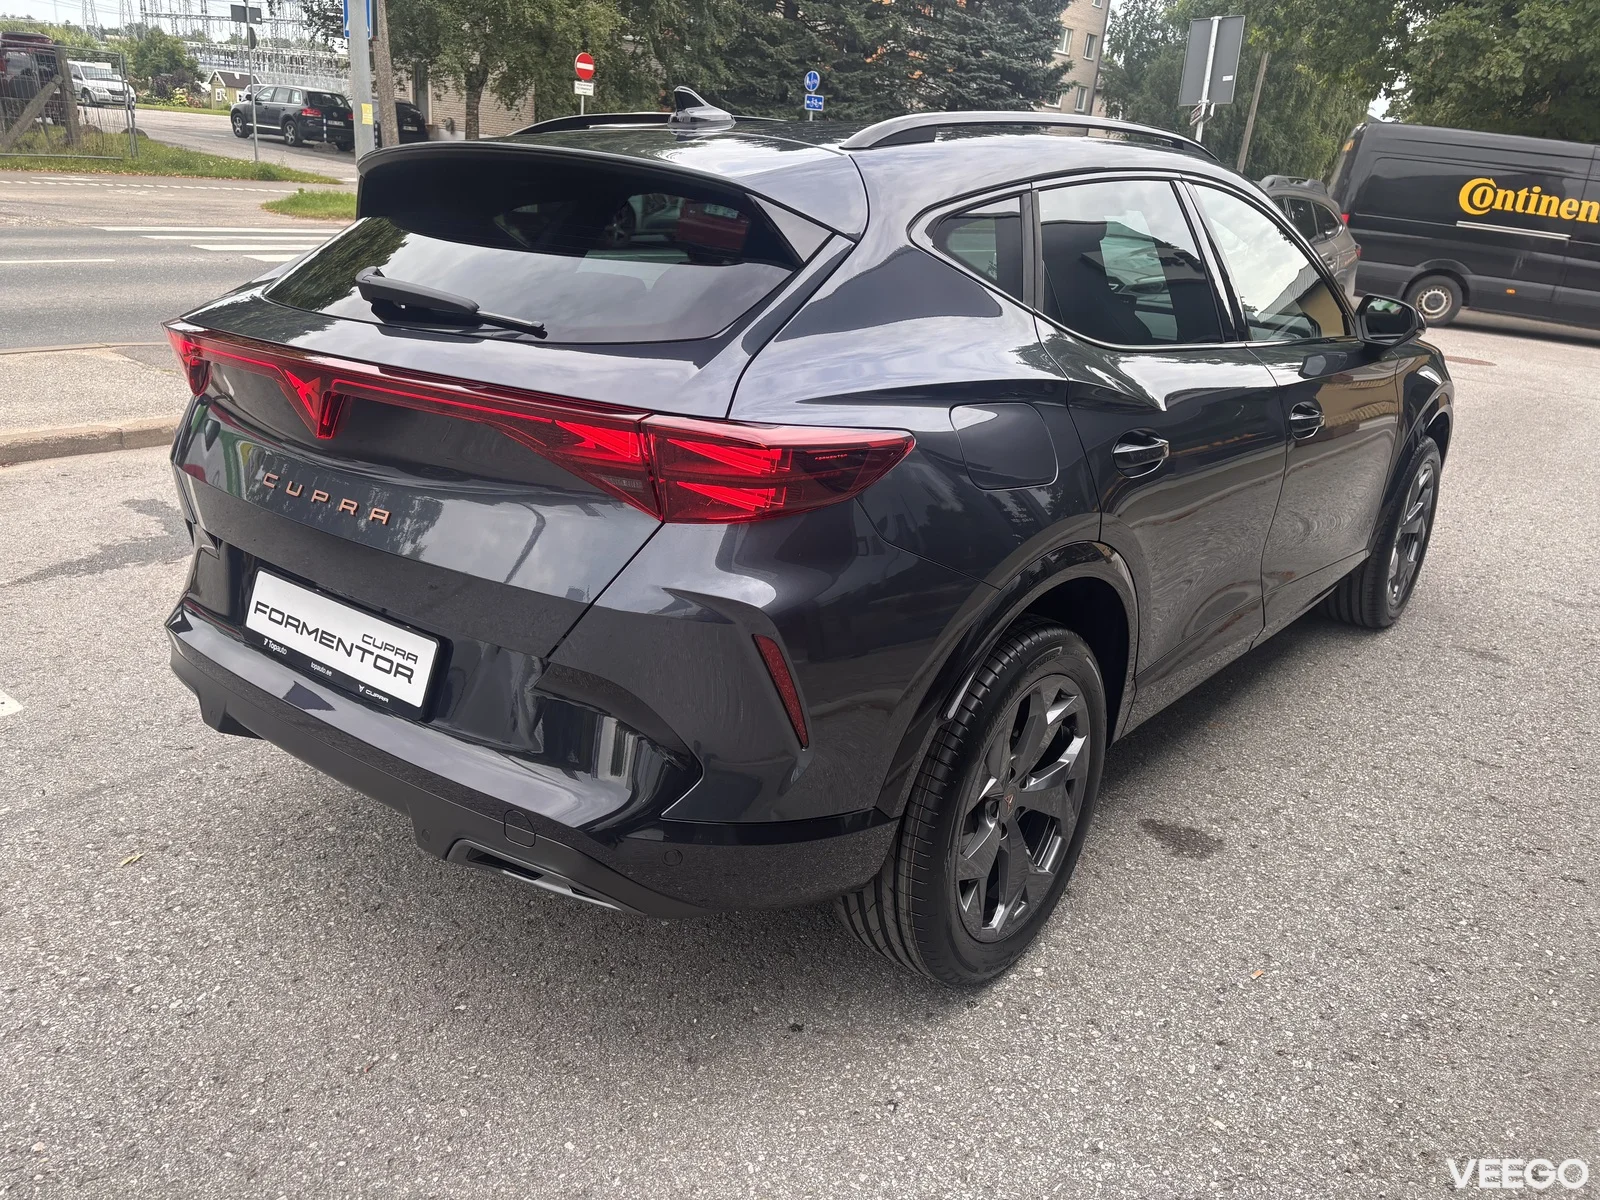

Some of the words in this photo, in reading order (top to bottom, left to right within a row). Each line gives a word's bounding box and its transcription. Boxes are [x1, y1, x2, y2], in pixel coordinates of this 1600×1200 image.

[1458, 177, 1600, 224] Continen
[263, 472, 392, 525] CUPRA
[253, 600, 415, 685] FORMENTOR
[268, 639, 288, 656] Topauto
[361, 633, 419, 665] CUPRA
[365, 688, 389, 703] CUPRA
